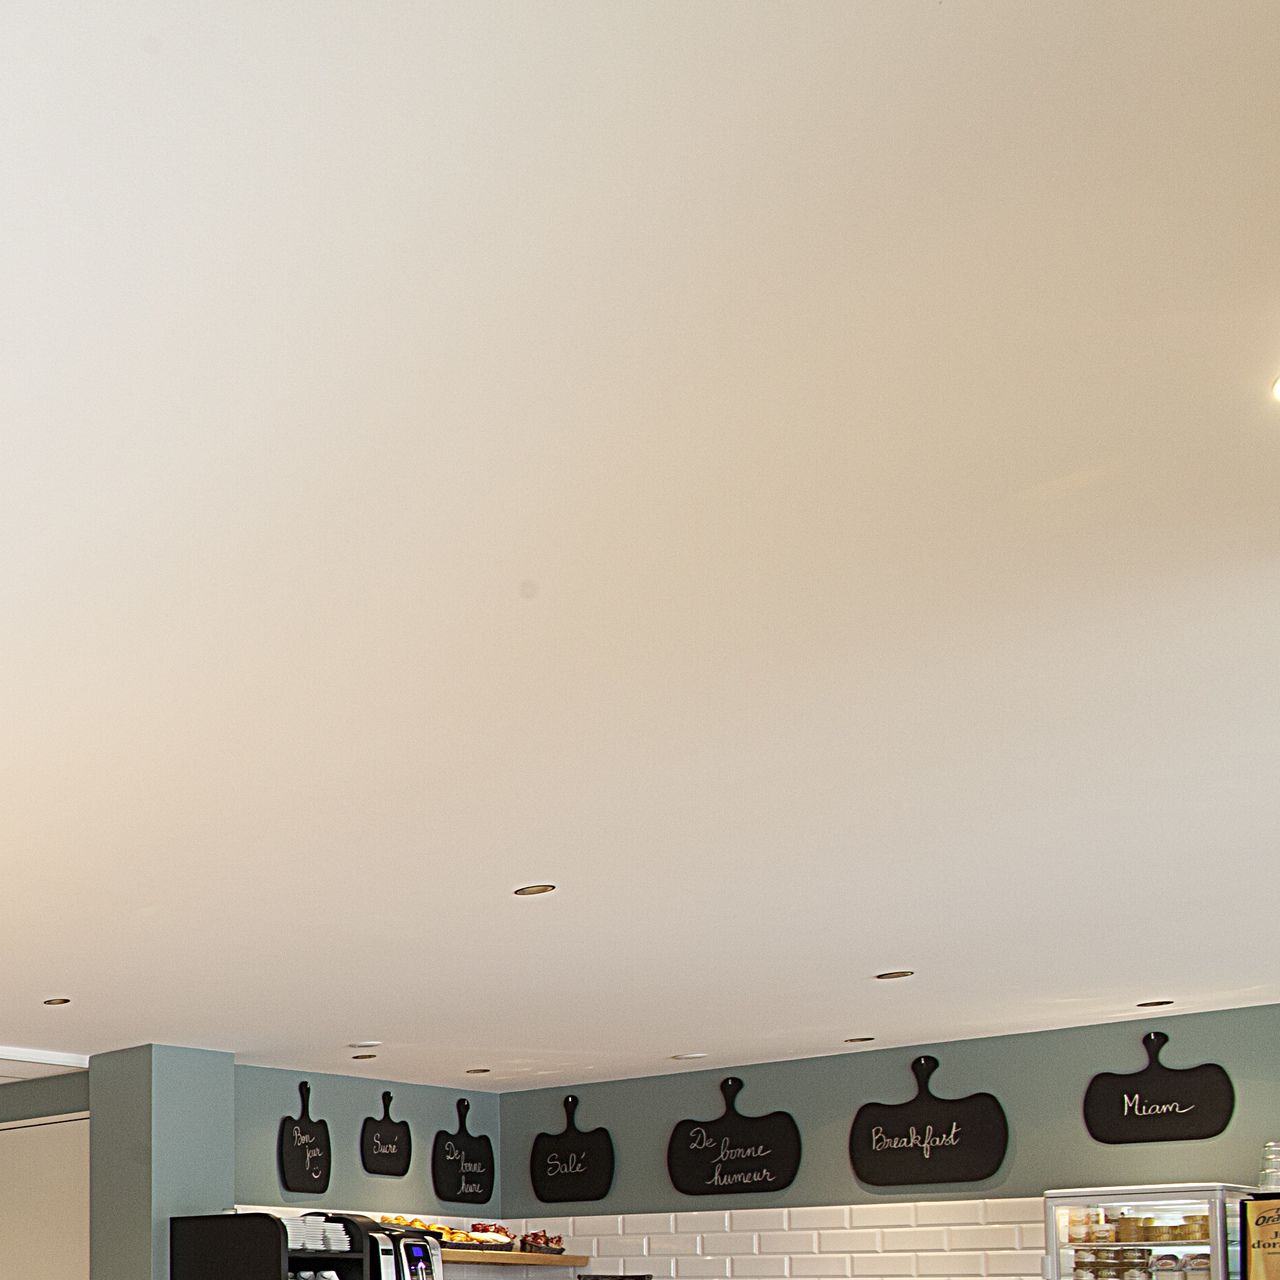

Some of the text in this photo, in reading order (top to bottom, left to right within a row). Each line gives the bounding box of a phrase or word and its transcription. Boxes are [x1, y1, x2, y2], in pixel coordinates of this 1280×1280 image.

[1123, 1093, 1195, 1116] Miam
[293, 1126, 316, 1147] Bon
[373, 1133, 398, 1154] Sucré
[689, 1127, 717, 1149] De
[871, 1122, 962, 1159] Breakfast
[305, 1145, 324, 1170] jour
[444, 1141, 461, 1160] De
[711, 1137, 772, 1163] bonne
[459, 1151, 487, 1173] bonne
[546, 1152, 589, 1176] Salé
[456, 1175, 484, 1195] heure
[705, 1164, 776, 1185] humeur
